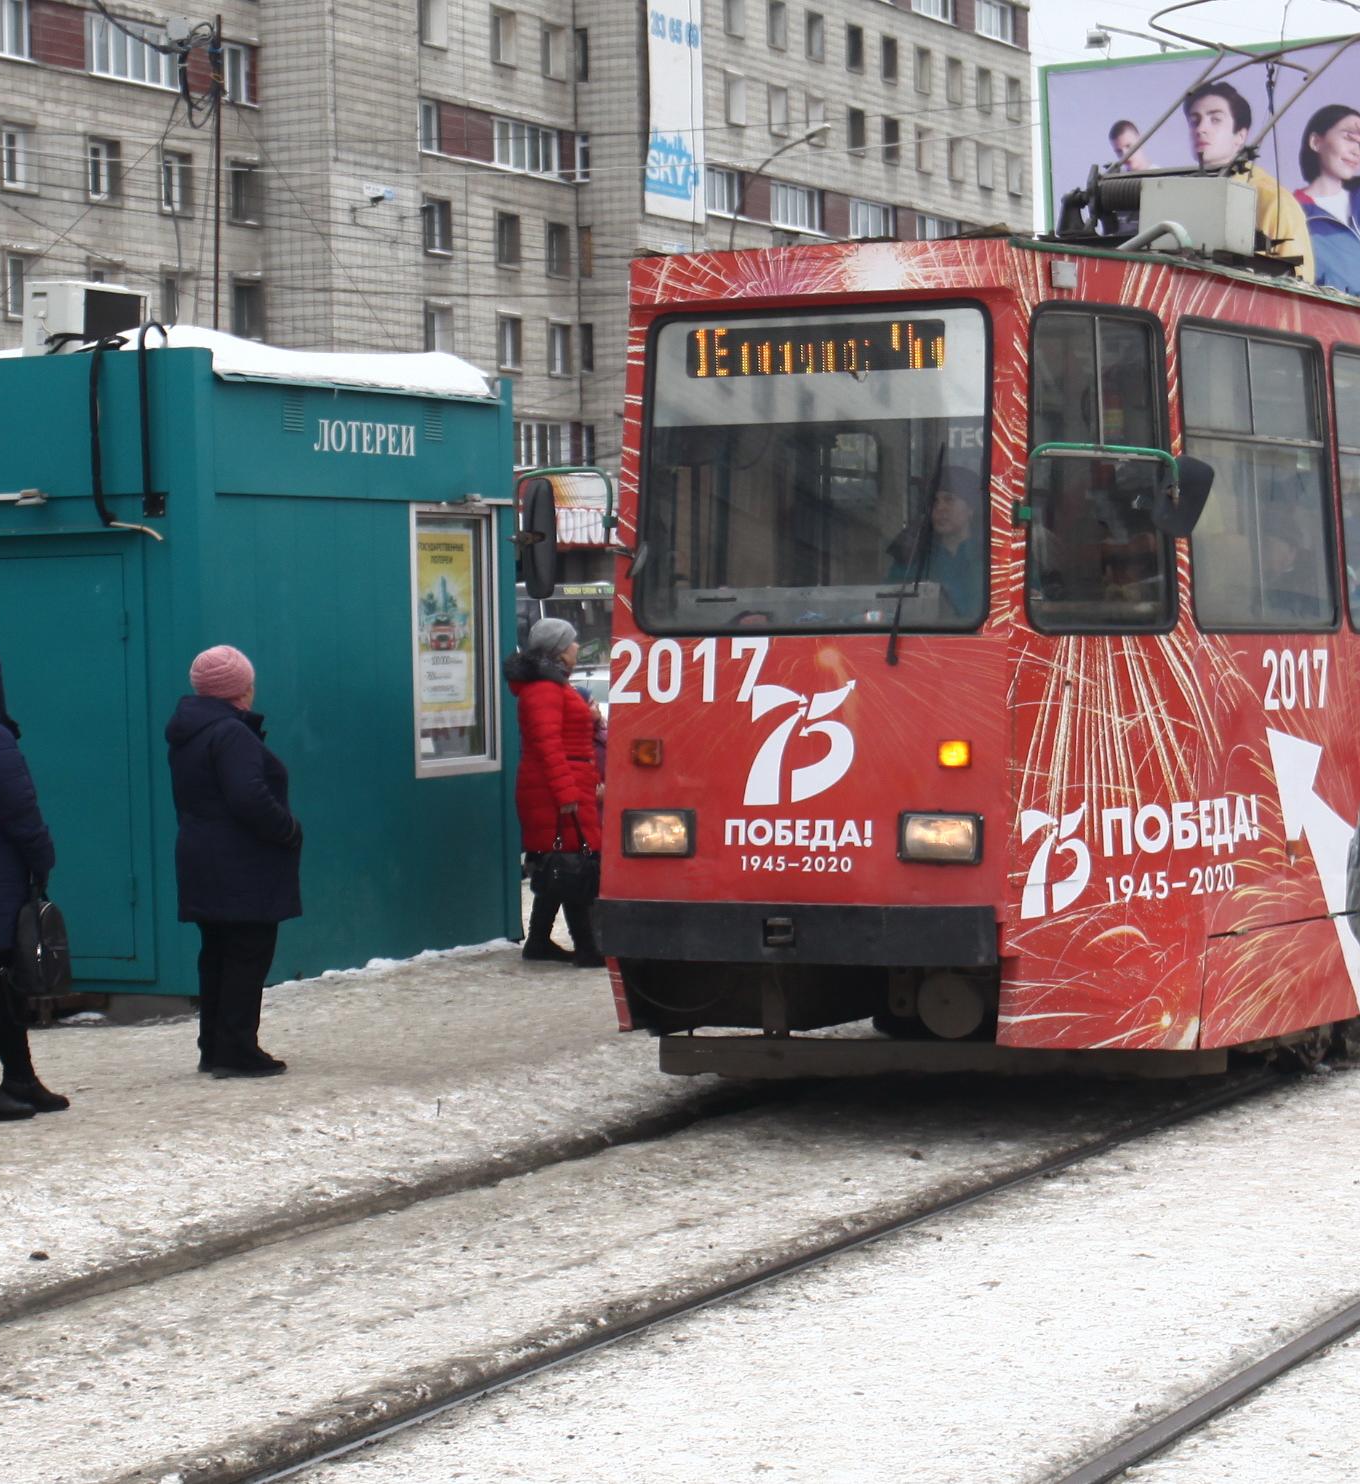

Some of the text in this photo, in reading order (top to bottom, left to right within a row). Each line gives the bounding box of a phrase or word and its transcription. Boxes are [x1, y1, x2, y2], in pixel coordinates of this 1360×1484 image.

[646, 151, 686, 187] SKY
[313, 419, 416, 456] ЛОТЕРЕИ
[608, 637, 770, 704] 2017
[1262, 648, 1328, 711] 2017
[743, 679, 856, 806] 75
[724, 818, 873, 852] ПОБЕДА!
[1101, 794, 1261, 857] ПОБЕДА!
[1021, 800, 1091, 920] 75
